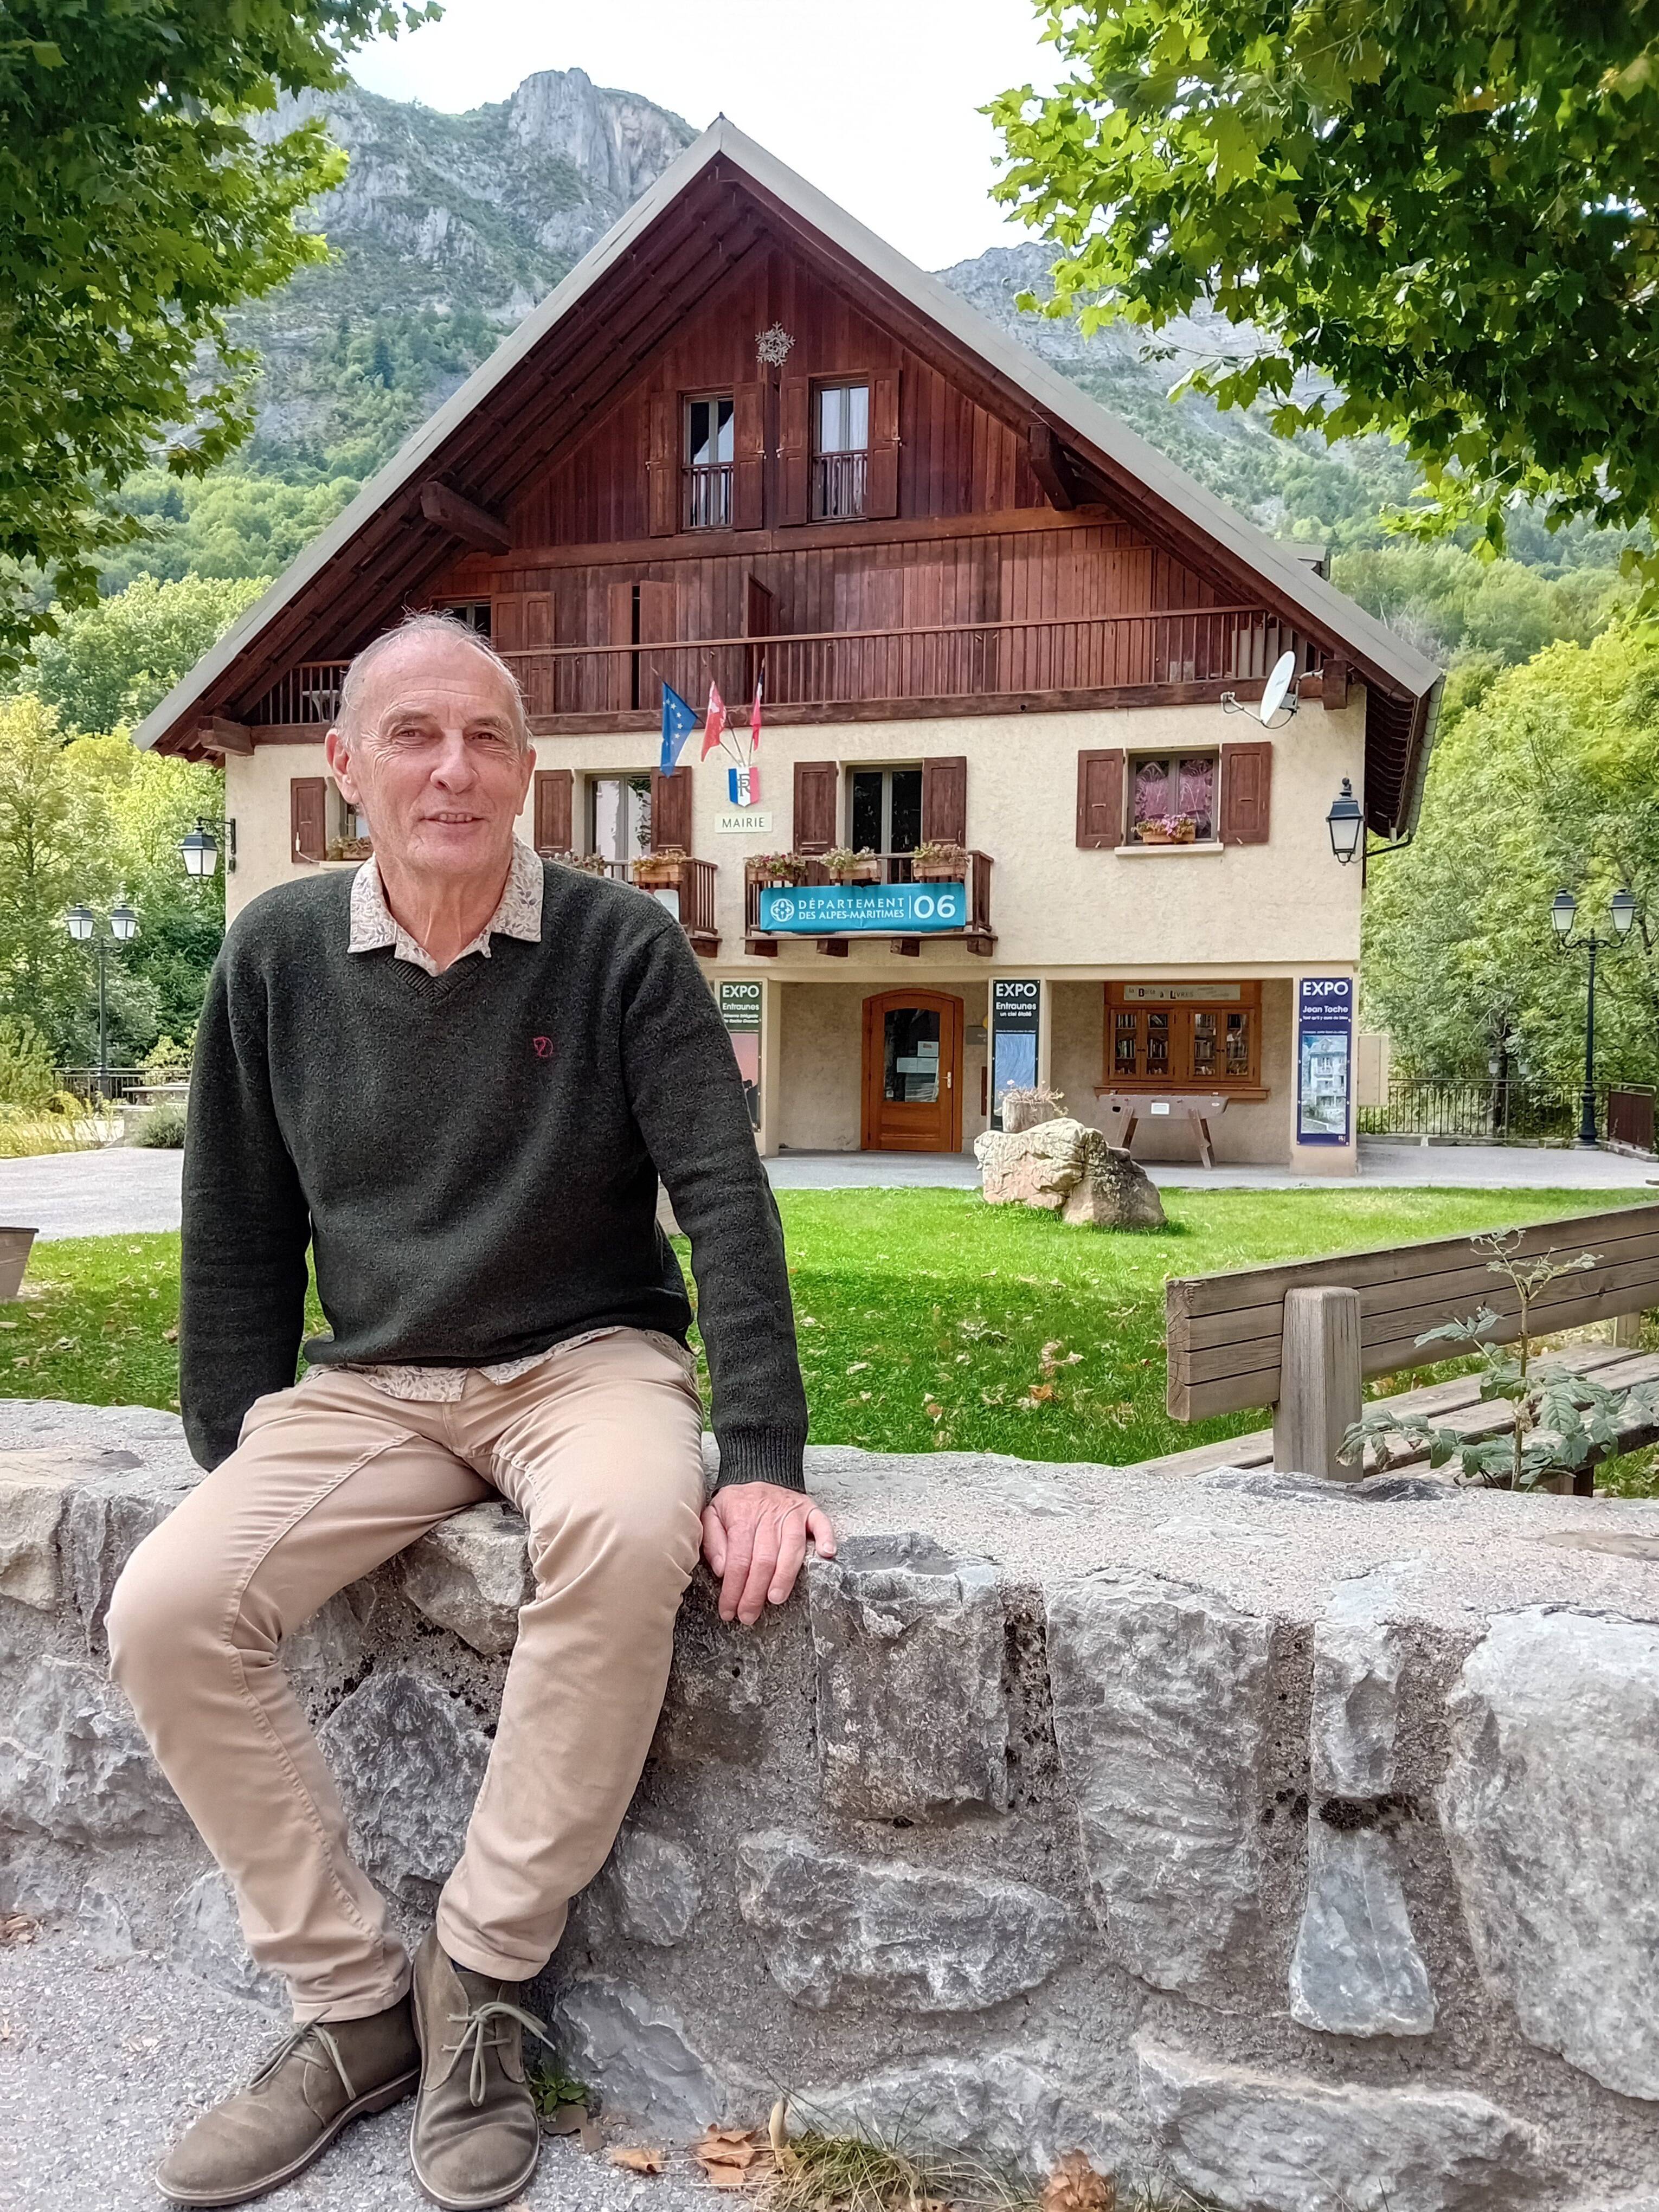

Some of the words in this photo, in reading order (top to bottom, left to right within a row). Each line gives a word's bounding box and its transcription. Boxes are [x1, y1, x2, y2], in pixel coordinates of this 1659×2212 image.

[722, 817, 765, 828] MAIRIE
[798, 897, 904, 910] DÉPARTEMENT
[914, 895, 956, 919] 06
[799, 911, 815, 920] DES
[819, 909, 904, 920] ALPES-MARITIMES
[722, 985, 760, 998] EXPO
[995, 983, 1037, 997] EXPO
[1302, 981, 1349, 996] EXPO
[722, 1002, 760, 1011] Entraunes
[995, 1002, 1037, 1010] Entraunes
[1302, 1005, 1323, 1013] Jean
[1324, 1005, 1348, 1013] Toche
